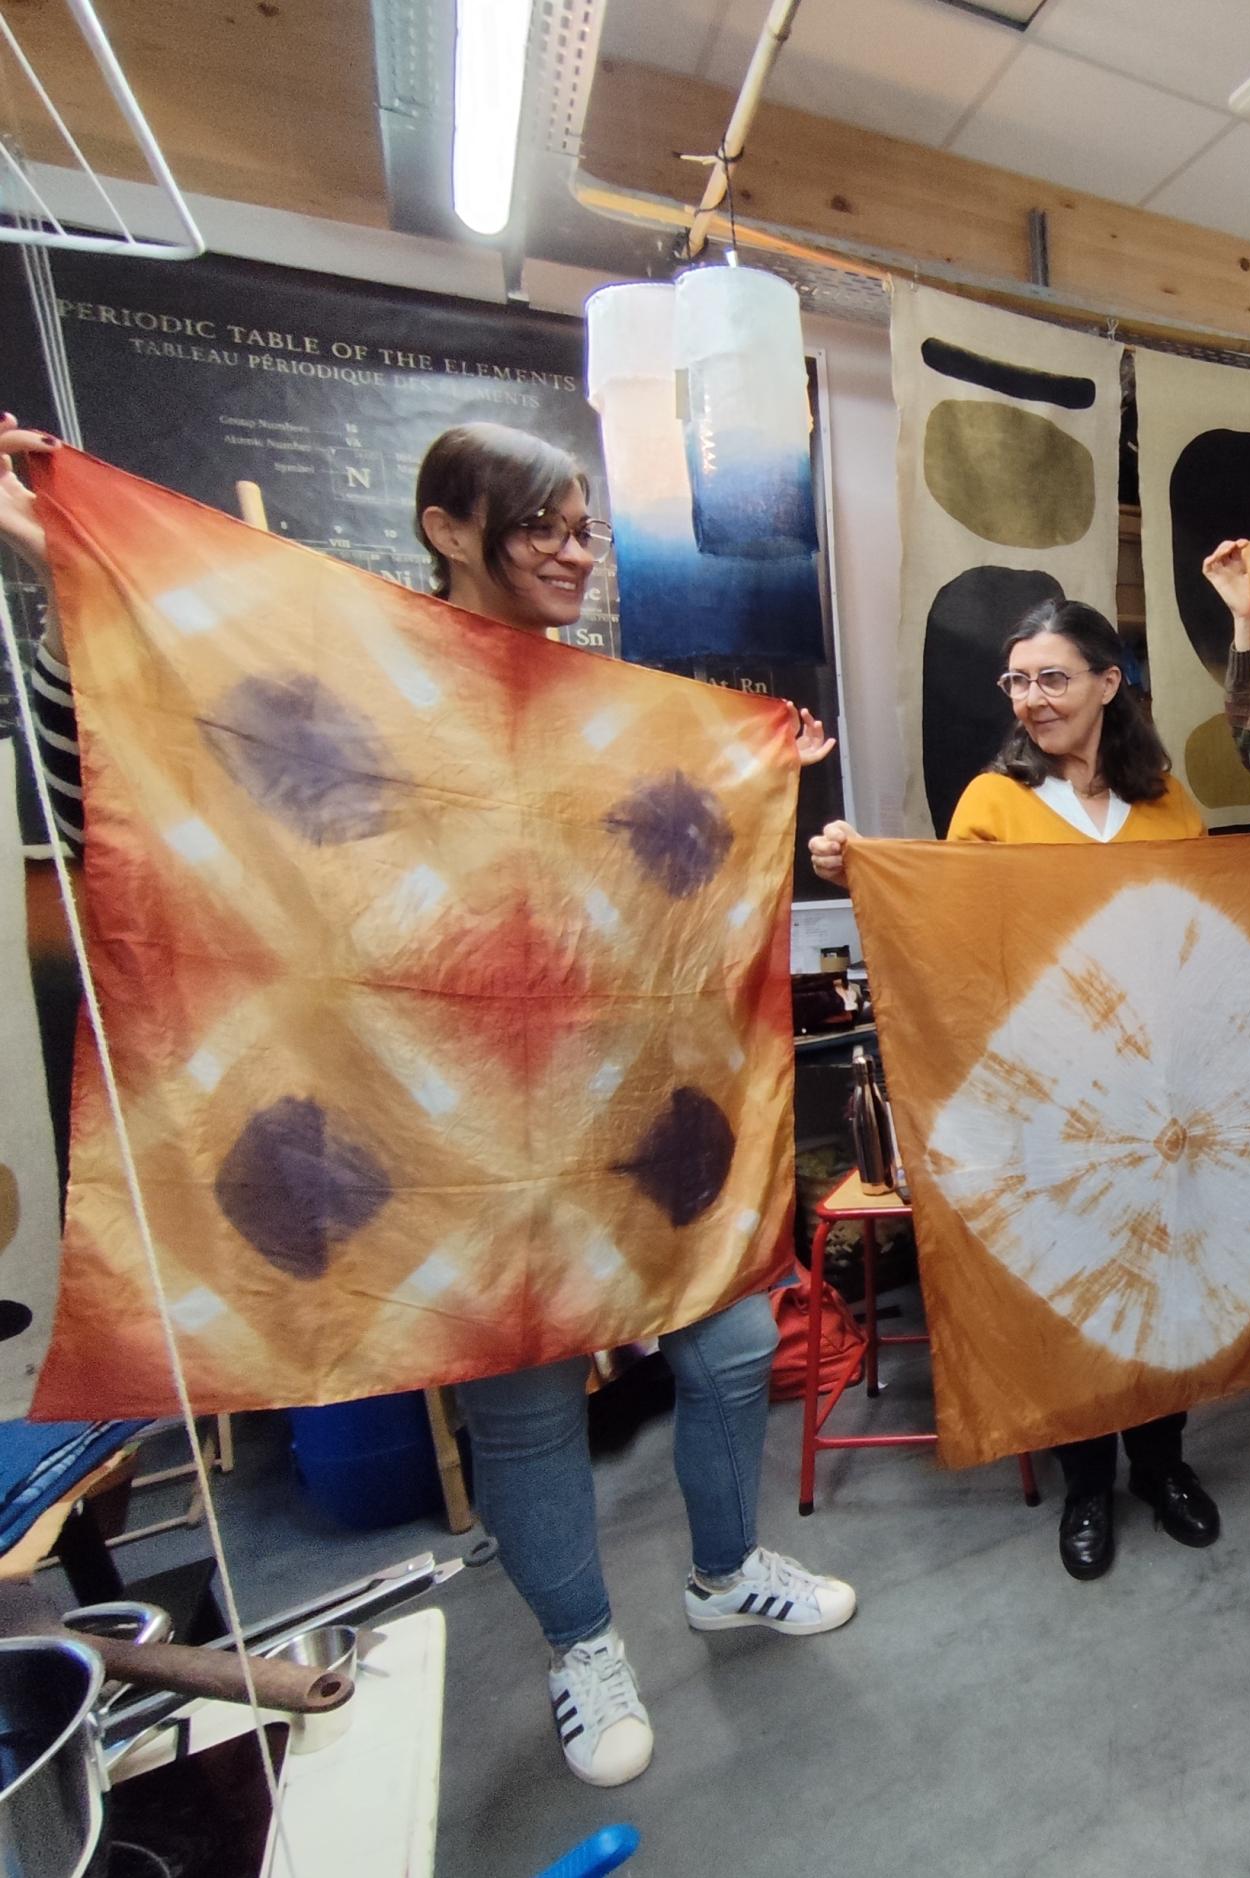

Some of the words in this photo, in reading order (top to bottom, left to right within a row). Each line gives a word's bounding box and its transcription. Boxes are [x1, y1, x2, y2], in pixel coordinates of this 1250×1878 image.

[57, 299, 216, 339] PERIODIC
[226, 325, 320, 355] TABLE
[331, 342, 368, 361] OF
[378, 349, 433, 372] THE
[443, 358, 577, 393] ELEMENTS
[129, 338, 240, 366] TABLEAU
[248, 353, 386, 387] PÉRIODIQUE
[393, 374, 432, 393] DES
[439, 377, 541, 409] LMENTS
[345, 466, 371, 488] N
[380, 570, 412, 590] Ni
[576, 628, 604, 646] Sn
[740, 678, 768, 693] Rn
